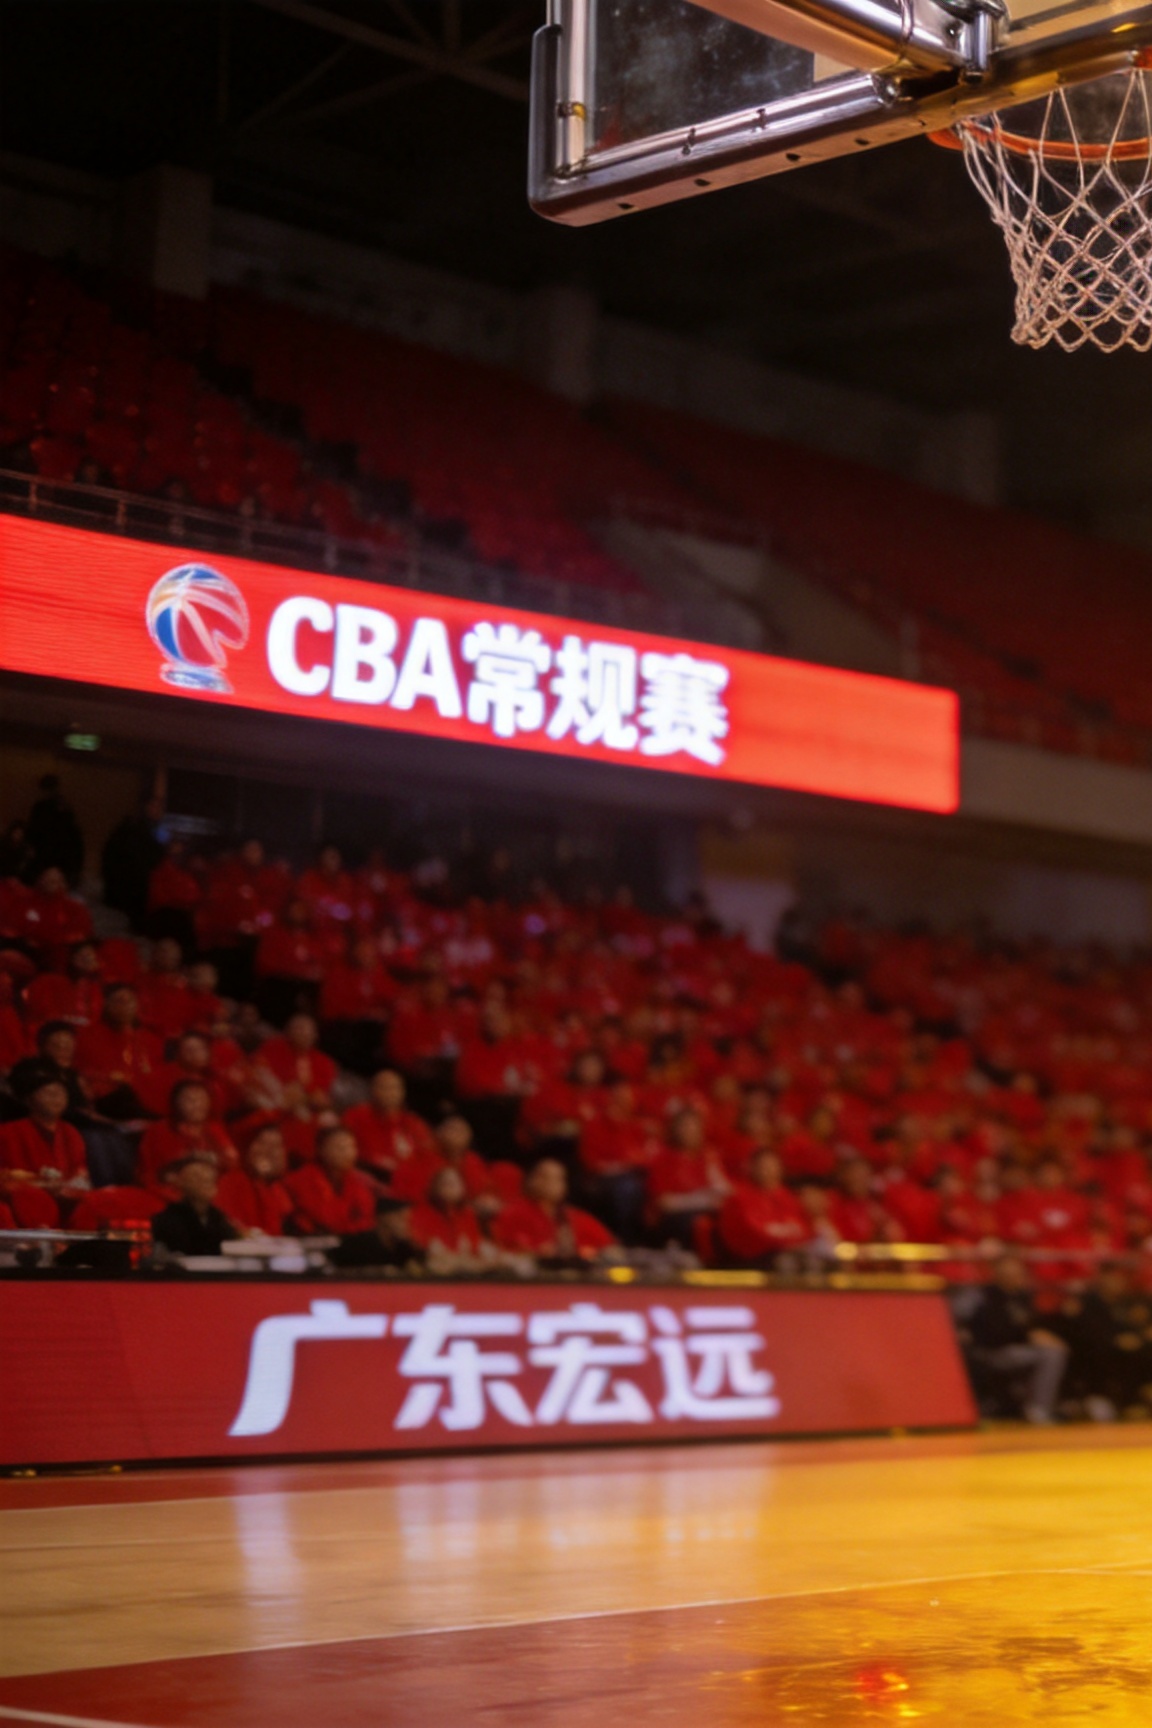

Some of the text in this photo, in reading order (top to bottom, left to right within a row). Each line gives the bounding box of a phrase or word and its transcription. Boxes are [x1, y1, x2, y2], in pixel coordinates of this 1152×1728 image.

[267, 596, 729, 765] CBA常规赛
[230, 1299, 778, 1437] 广东宏远
